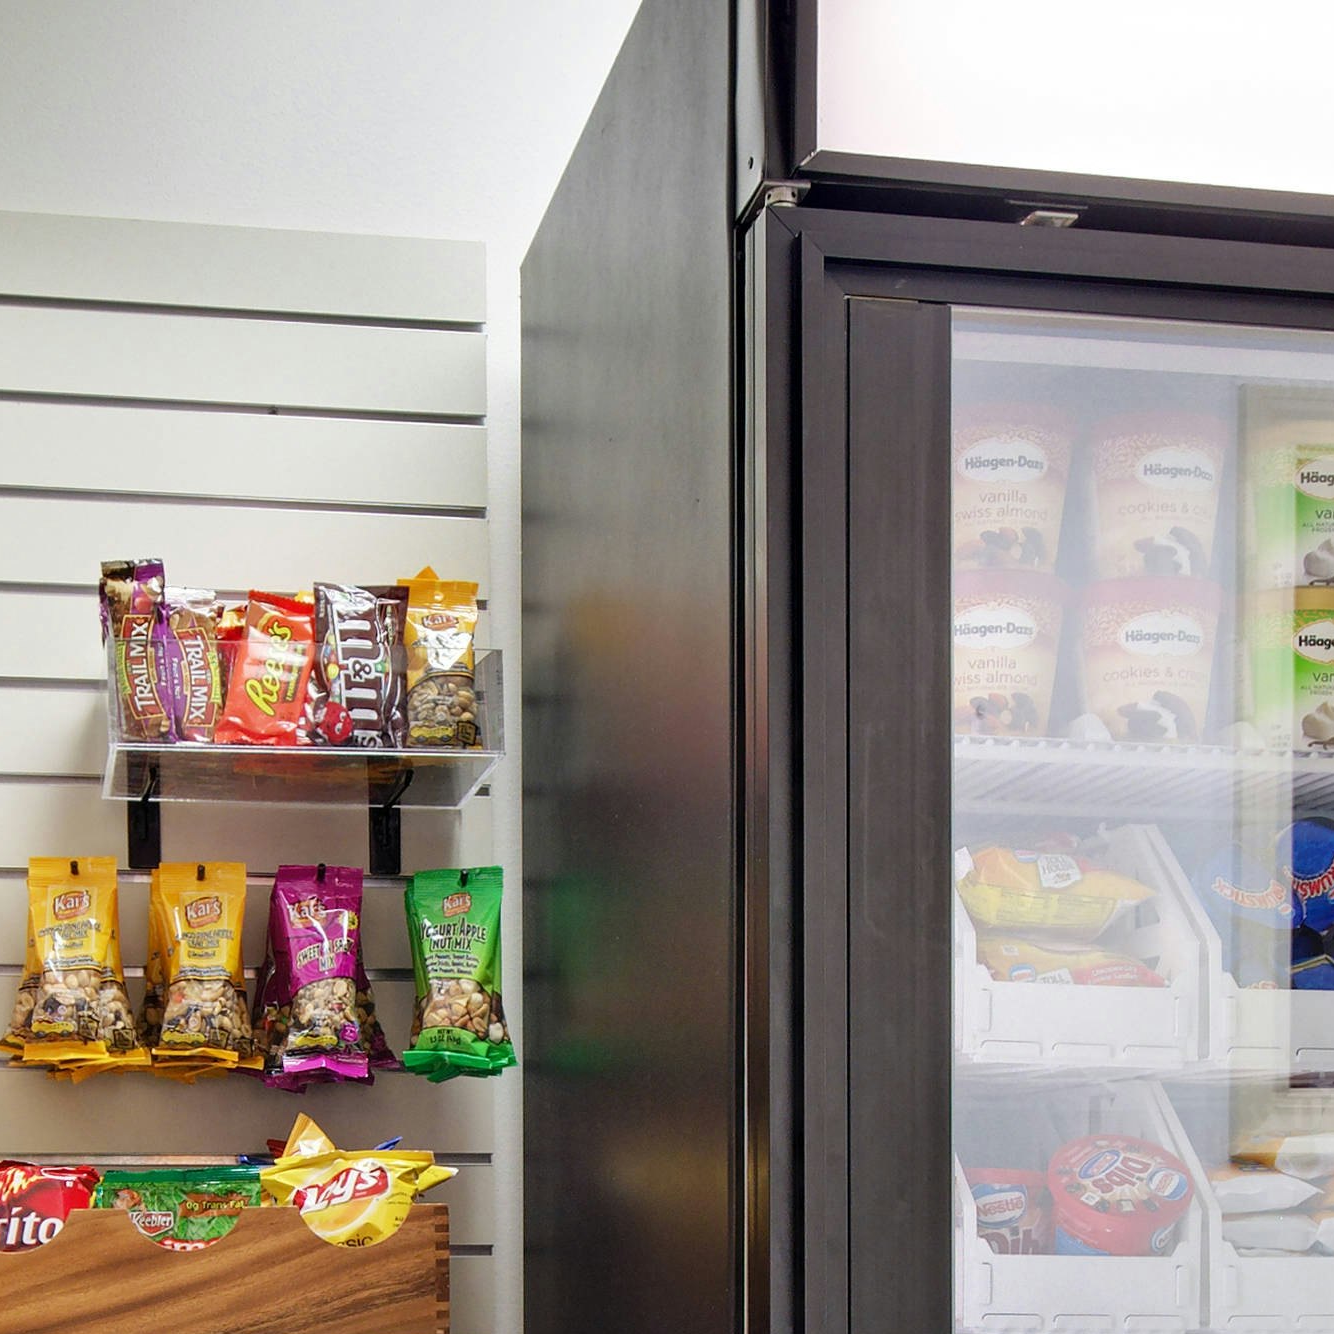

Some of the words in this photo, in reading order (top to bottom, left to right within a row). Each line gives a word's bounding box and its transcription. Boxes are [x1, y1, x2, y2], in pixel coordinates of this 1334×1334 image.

[965, 455, 1044, 471] Häagen-Dazs
[1143, 464, 1213, 481] Häagen-Dazs
[979, 490, 1028, 504] vanilla
[996, 505, 1048, 521] almond
[1118, 501, 1177, 516] cookies
[129, 622, 148, 656] MIX
[1125, 630, 1200, 644] Häagen-Dazs
[183, 636, 207, 684] TRAIL
[967, 656, 1017, 669] vanilla
[986, 671, 1037, 686] almond
[1102, 666, 1160, 682] cookies
[131, 659, 155, 711] TRAIL
[190, 687, 208, 719] MIX
[54, 890, 91, 912] Kar's
[186, 898, 221, 919] Kar's
[442, 893, 471, 911] Kar's
[458, 919, 487, 941] APPLE
[432, 938, 452, 950] NUT
[455, 938, 472, 950] MIX
[296, 944, 320, 967] SWEET
[319, 956, 335, 971] MIX
[301, 1167, 385, 1210] Lay's
[201, 1199, 229, 1209] Trans
[231, 1199, 247, 1209] Fat
[130, 1211, 174, 1232] Keebler
